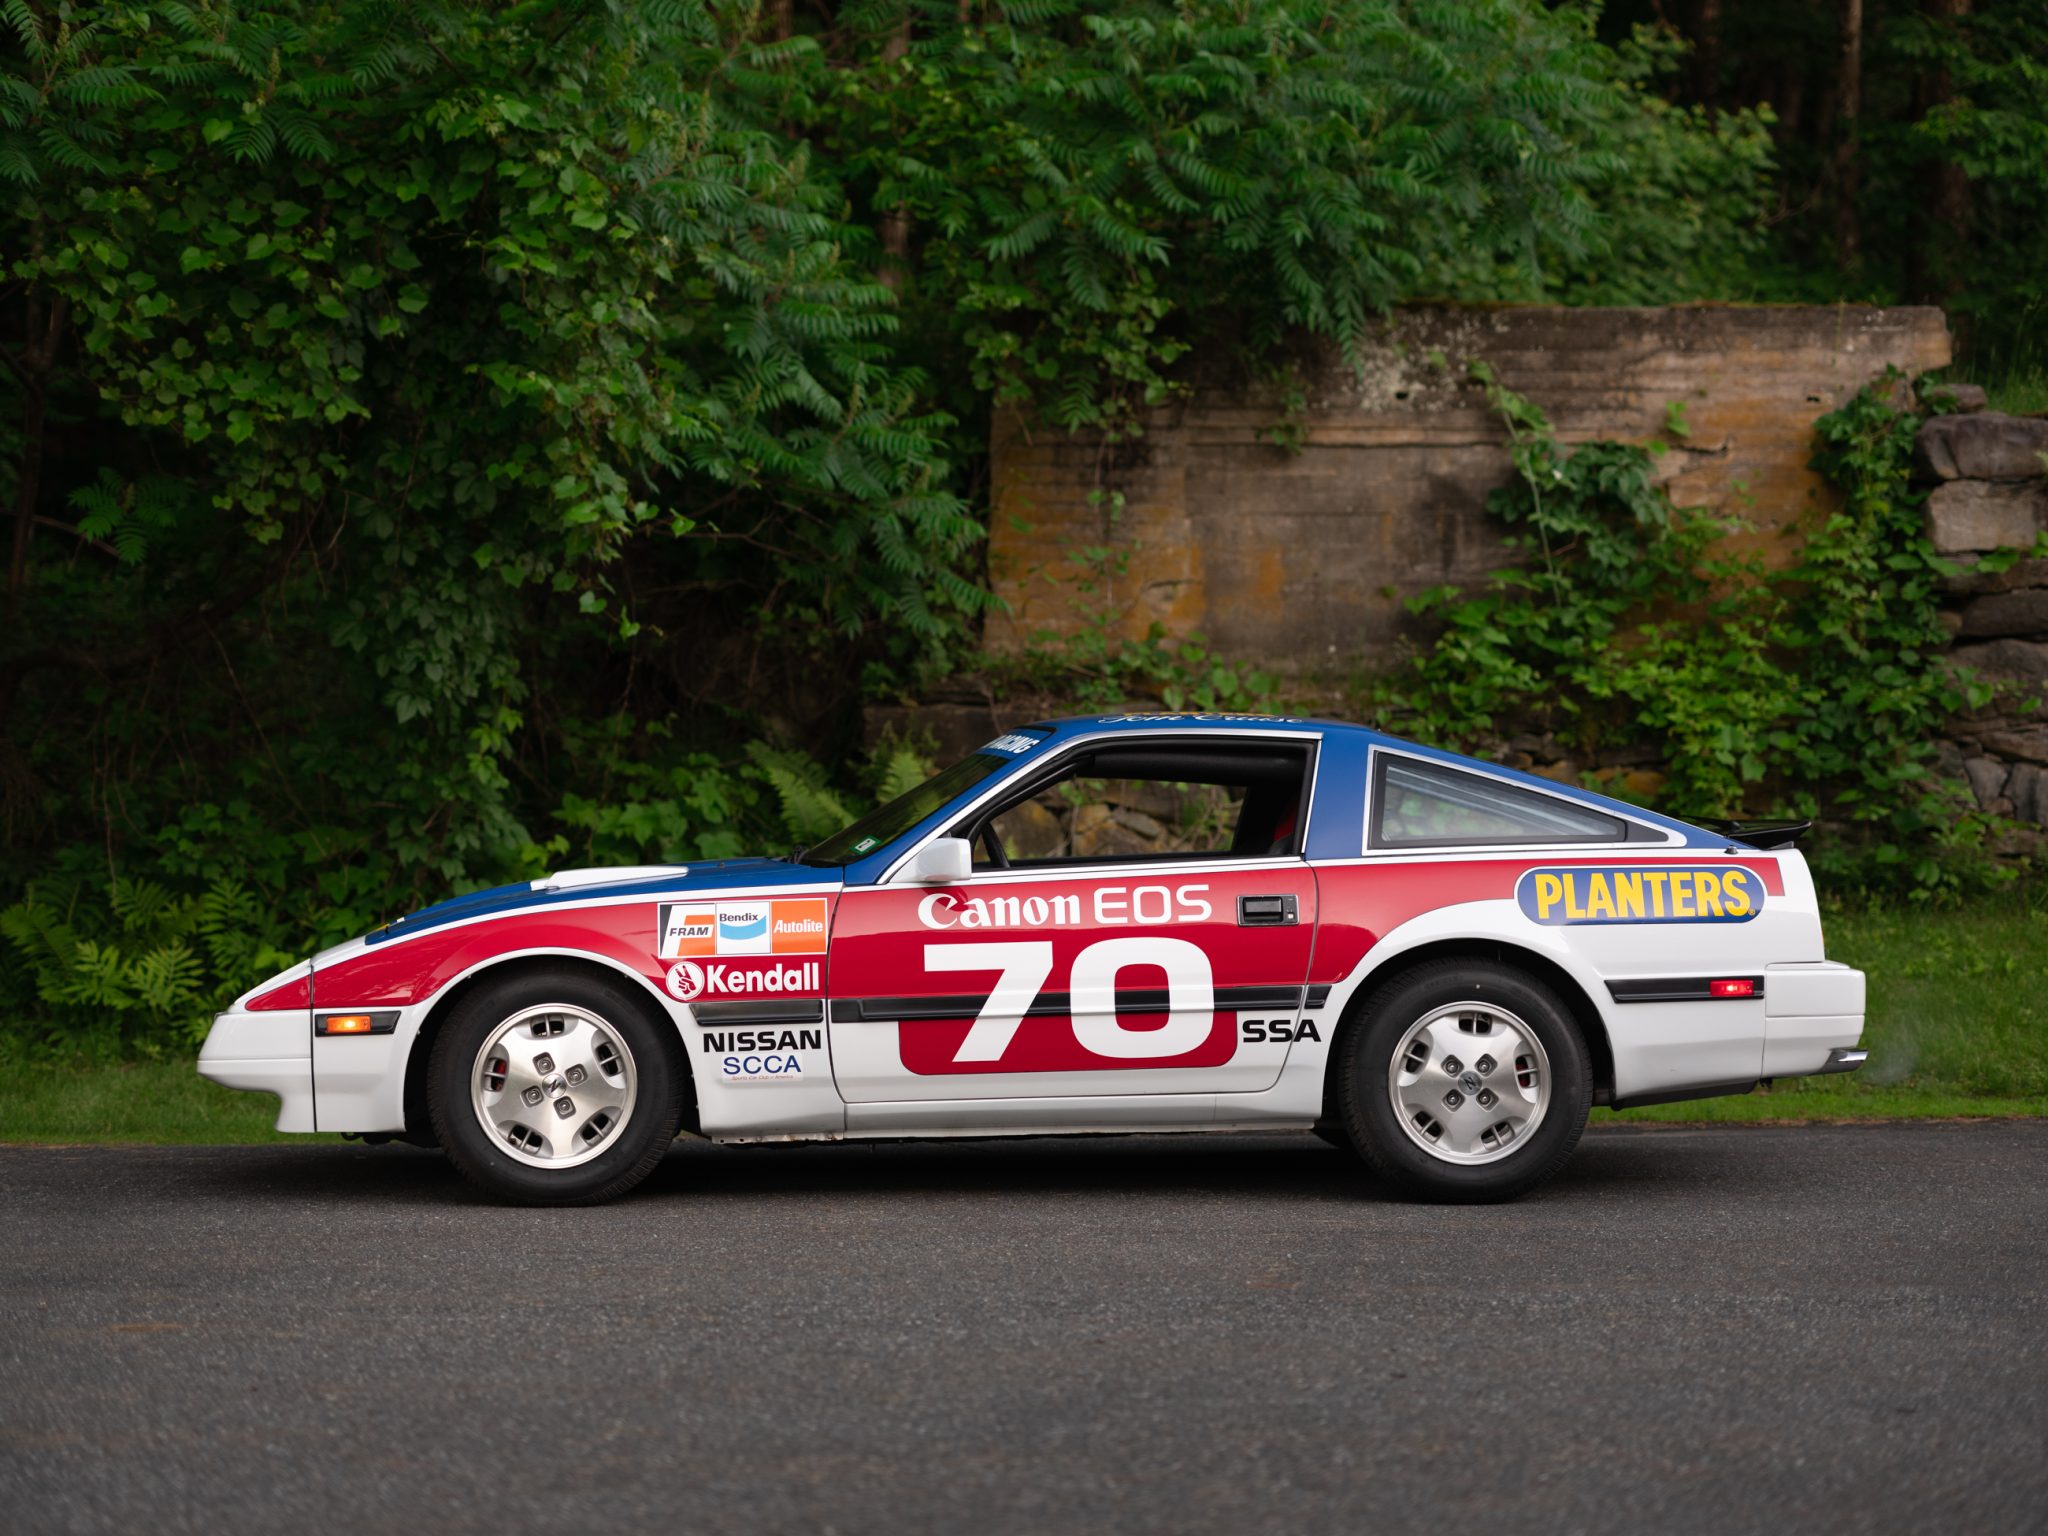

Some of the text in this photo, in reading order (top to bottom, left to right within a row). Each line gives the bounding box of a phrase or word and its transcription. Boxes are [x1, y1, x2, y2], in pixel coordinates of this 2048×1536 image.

[917, 884, 1213, 929] Canon EOS
[1534, 870, 1751, 920] PLANTERS
[719, 912, 759, 922] Bendix
[773, 919, 824, 934] Autolite
[669, 926, 710, 937] FRAM
[706, 962, 820, 993] Kendall
[923, 936, 1215, 1063] 70
[703, 1030, 822, 1053] NISSAN
[1242, 1019, 1322, 1043] SSA
[723, 1055, 802, 1075] SCCA
